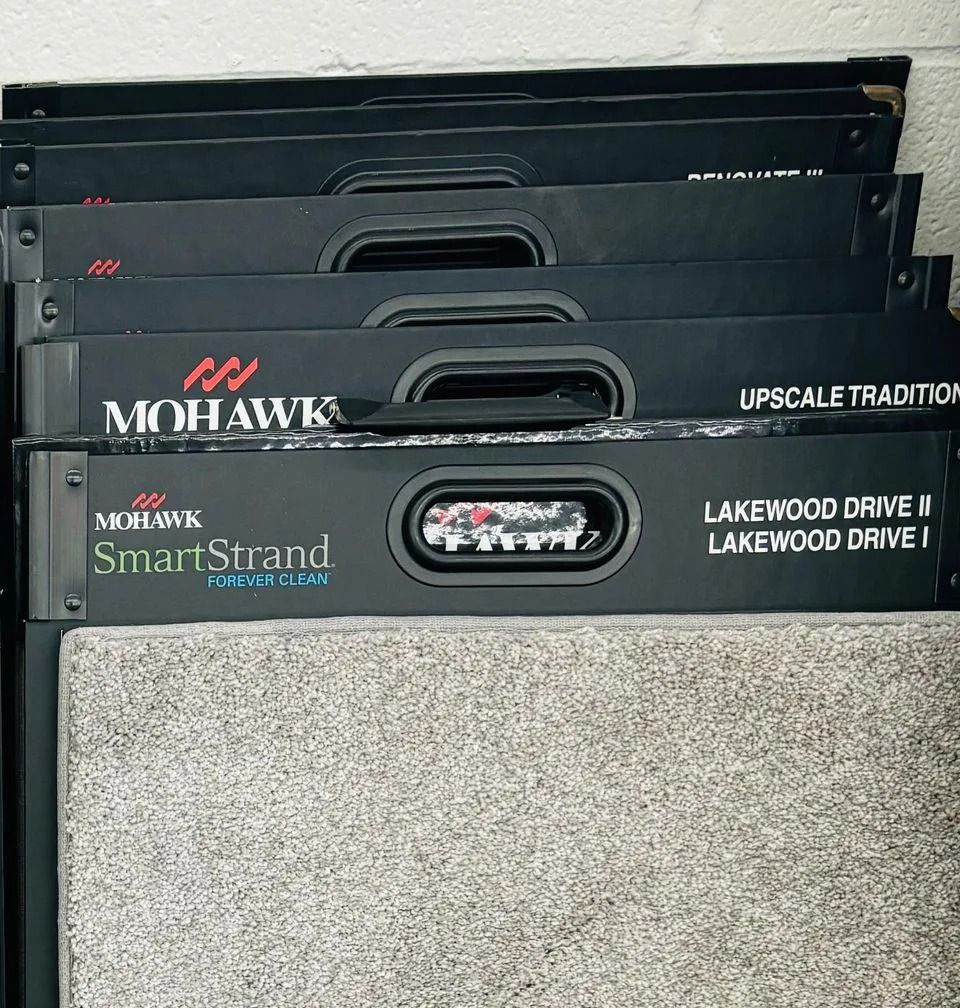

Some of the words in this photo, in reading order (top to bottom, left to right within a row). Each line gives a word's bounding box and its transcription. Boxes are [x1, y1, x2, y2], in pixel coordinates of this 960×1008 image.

[740, 385, 845, 411] UPSCALE
[102, 396, 338, 434] MOHAWK
[94, 510, 203, 531] MOHAWK
[704, 497, 838, 523] LAKEWOOD
[843, 495, 913, 519] DRIVE
[918, 494, 932, 517] II
[708, 528, 841, 554] LAKEWOOD
[847, 526, 917, 551] DRIVE
[922, 525, 929, 548] I
[207, 574, 275, 588] FOREVER
[278, 572, 328, 586] CLEAN
